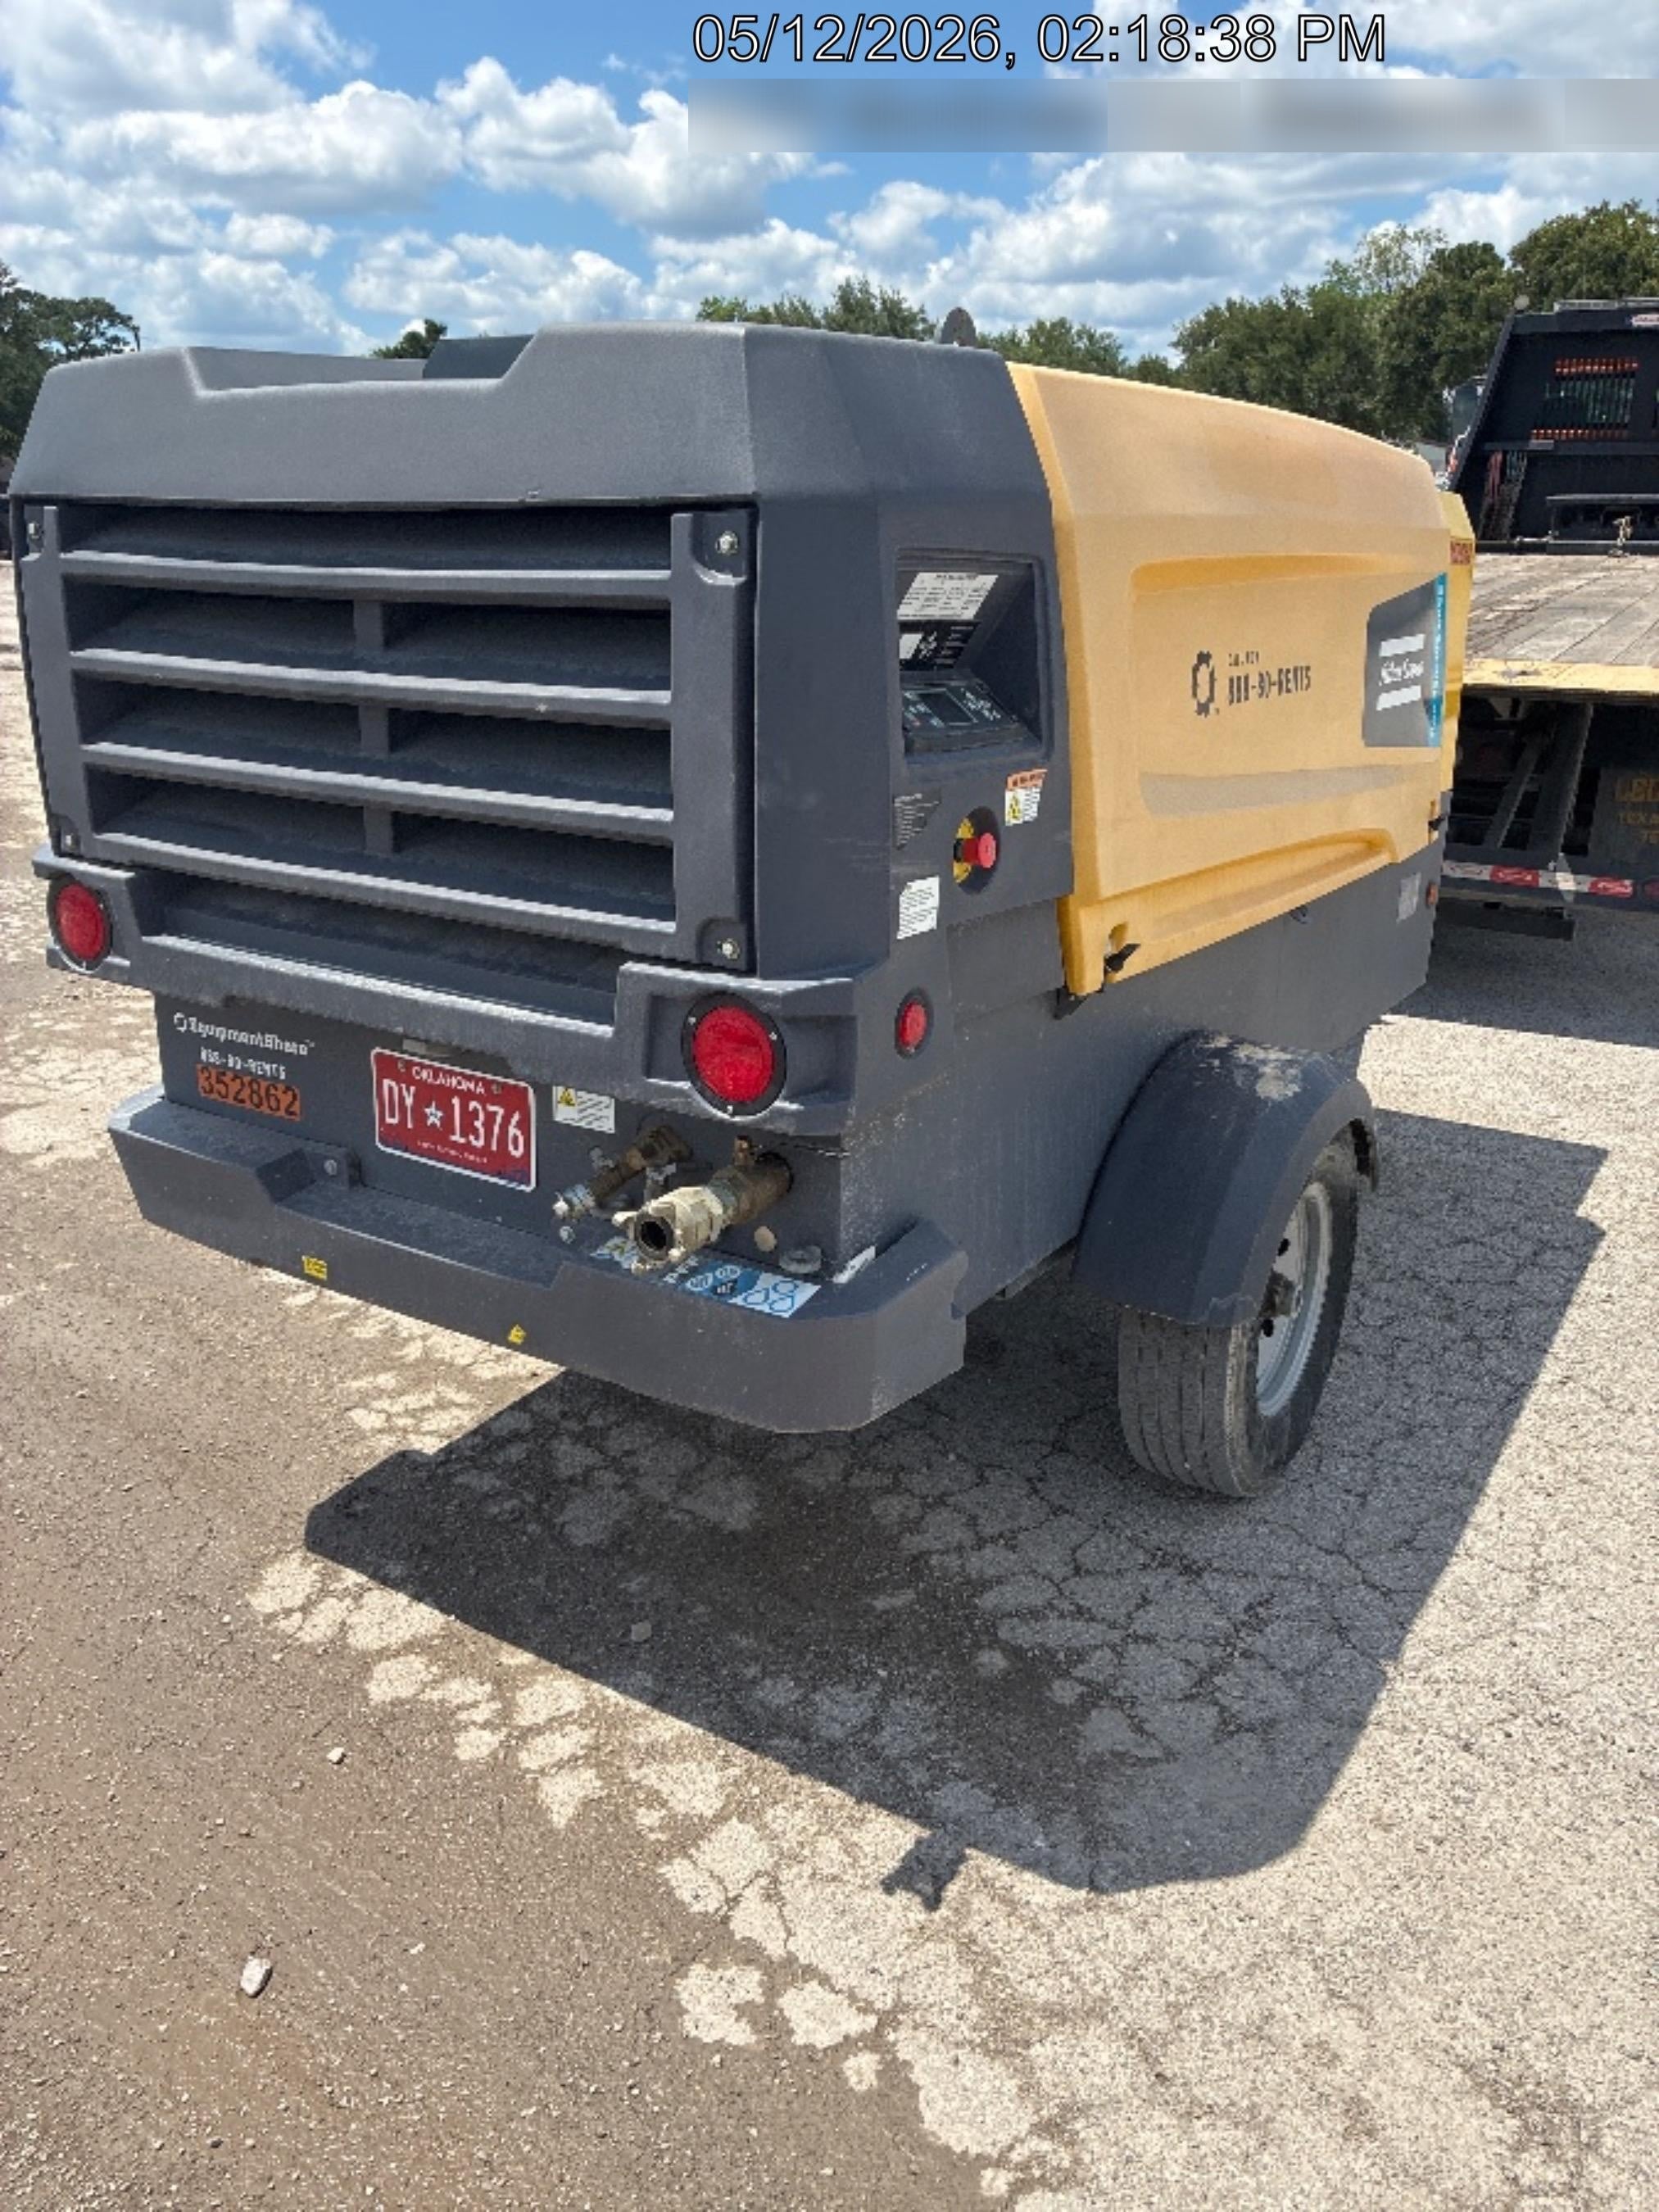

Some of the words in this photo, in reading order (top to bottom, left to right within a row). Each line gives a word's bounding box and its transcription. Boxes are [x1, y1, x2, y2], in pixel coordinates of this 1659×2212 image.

[200, 1066, 298, 1116] 352862
[412, 1066, 486, 1095] OKLAHOMA
[383, 1078, 416, 1129] DY
[450, 1095, 524, 1158] 1376
